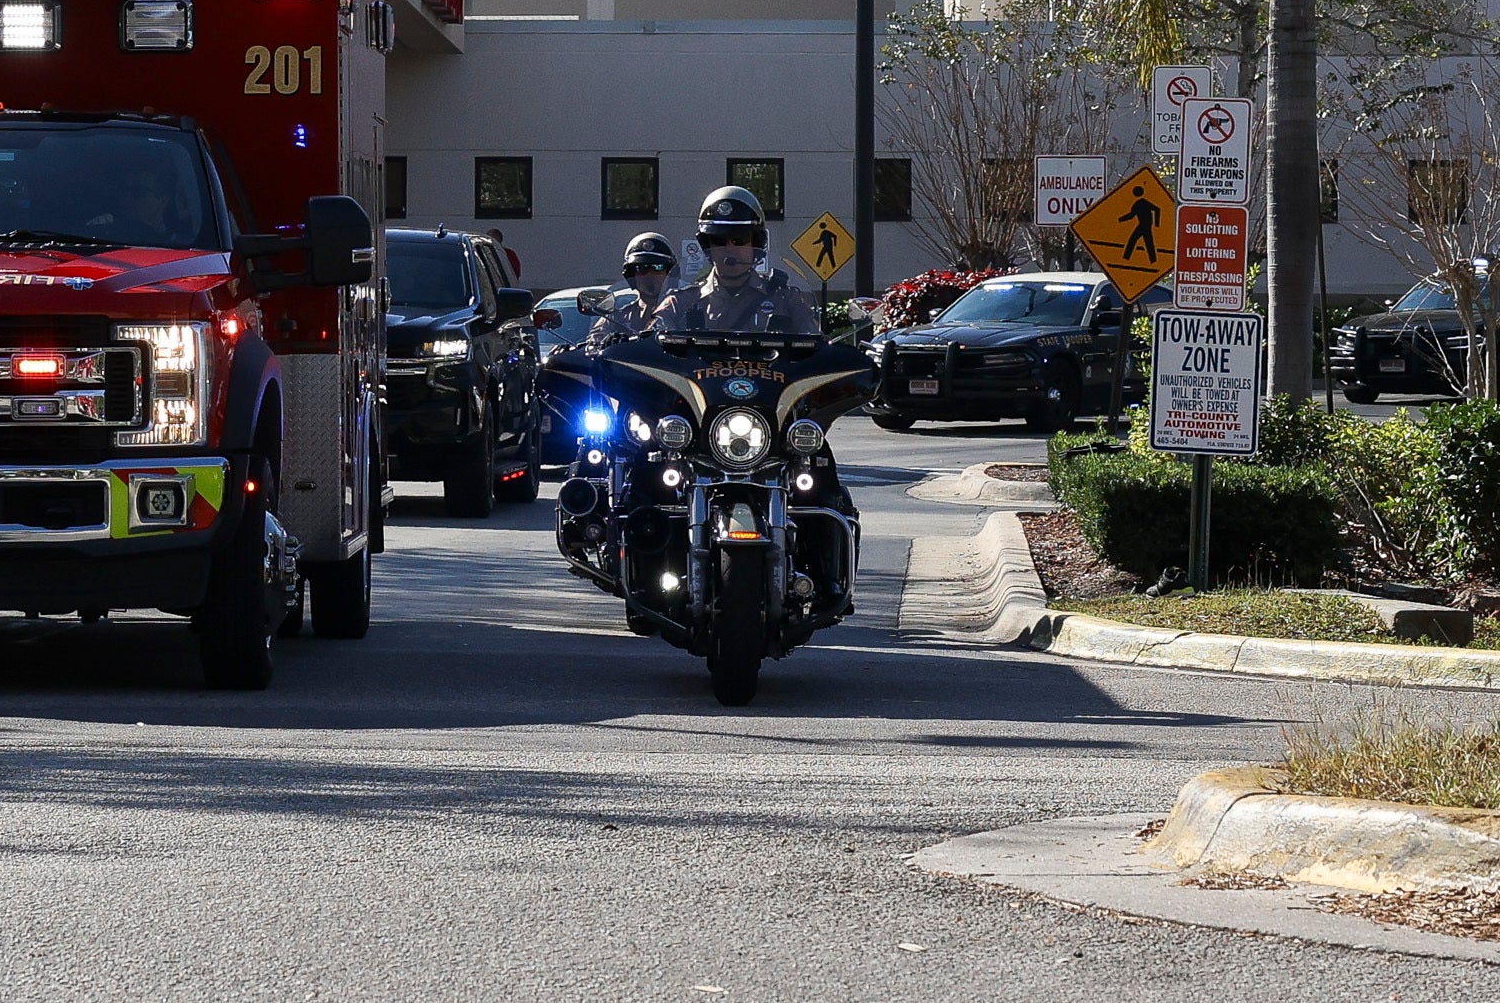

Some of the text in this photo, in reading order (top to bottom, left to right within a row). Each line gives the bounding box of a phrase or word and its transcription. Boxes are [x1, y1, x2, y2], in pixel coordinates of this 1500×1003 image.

[243, 45, 322, 94] 201
[1208, 145, 1222, 156] NO
[1190, 157, 1239, 168] FIREARMS
[1184, 167, 1245, 180] OR WEAPONS
[1039, 176, 1103, 190] AMBULANCE
[1194, 179, 1223, 187] ALLOWED
[1205, 187, 1238, 196] PROPERTY
[1047, 197, 1094, 214] ONLY
[1205, 213, 1219, 224] NO
[1185, 224, 1239, 236] SOLICITING
[1204, 237, 1219, 248] NO
[1186, 248, 1236, 259] LOITERING
[1203, 261, 1217, 272] NO
[1178, 271, 1243, 284] TRESPASSING
[1179, 286, 1239, 296] VIOLATORS WILL
[1180, 295, 1238, 305] BE PROSECUTED
[1160, 317, 1257, 346] TOW-AWAY
[711, 360, 768, 370] STATE
[1181, 346, 1231, 373] ZONE
[692, 367, 786, 385] TROOPER
[1160, 374, 1252, 390] UNAUTHORIZED VEHICLES
[1171, 387, 1240, 401] WILL BE TOWED AT
[1171, 399, 1239, 413] OWNER'S EXPENSE
[1166, 410, 1240, 422] TRI-COUNTY
[1163, 420, 1242, 431] AUTOMOTIVE
[1177, 429, 1226, 439] TOWING
